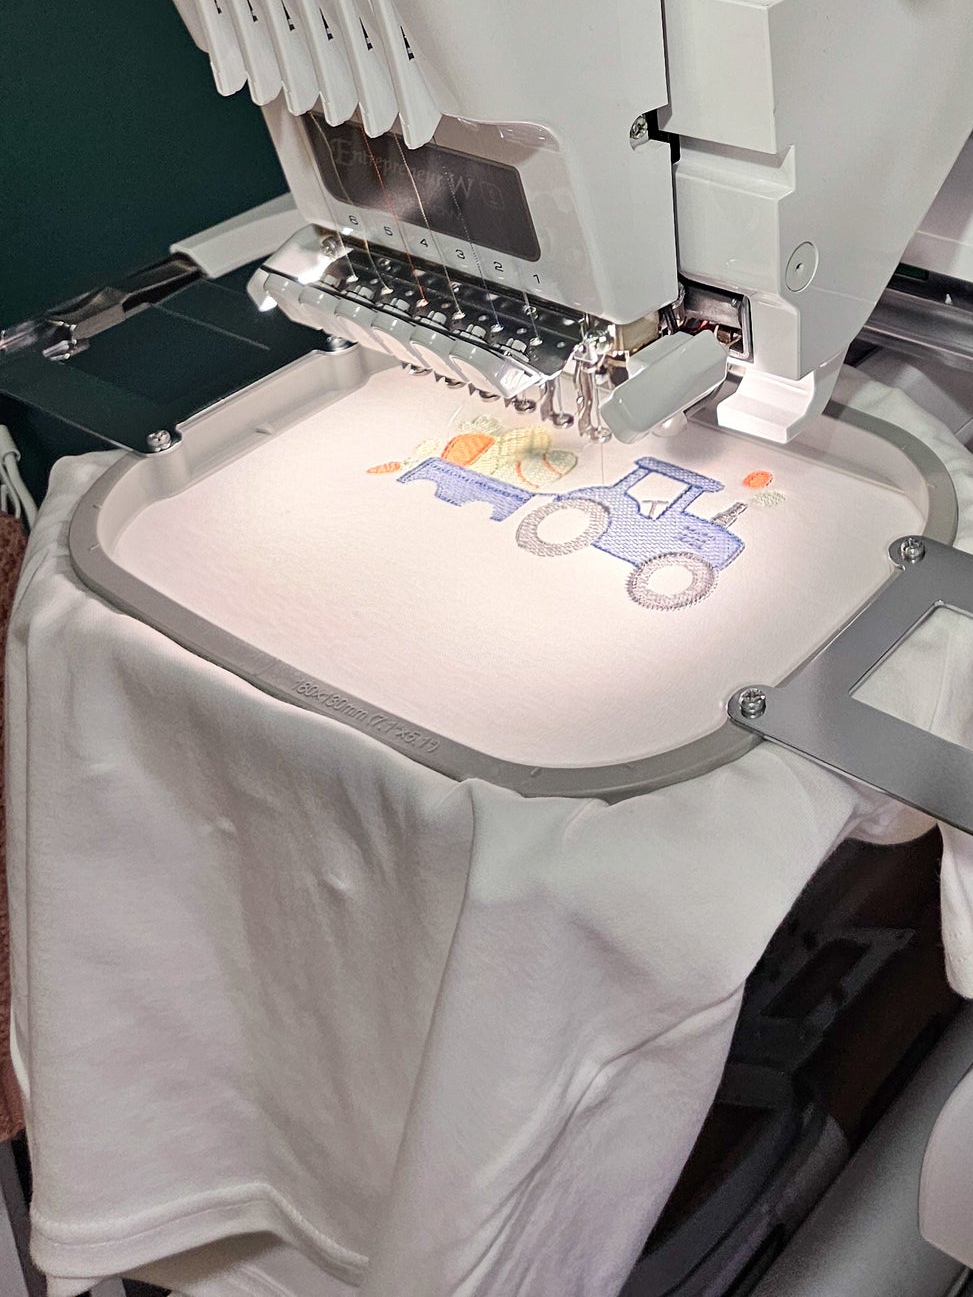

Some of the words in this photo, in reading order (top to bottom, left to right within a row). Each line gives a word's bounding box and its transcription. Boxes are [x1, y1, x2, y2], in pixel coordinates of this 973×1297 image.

[383, 225, 393, 237] 5
[420, 238, 430, 248] 4
[456, 249, 466, 260] 3
[493, 261, 504, 273] 2
